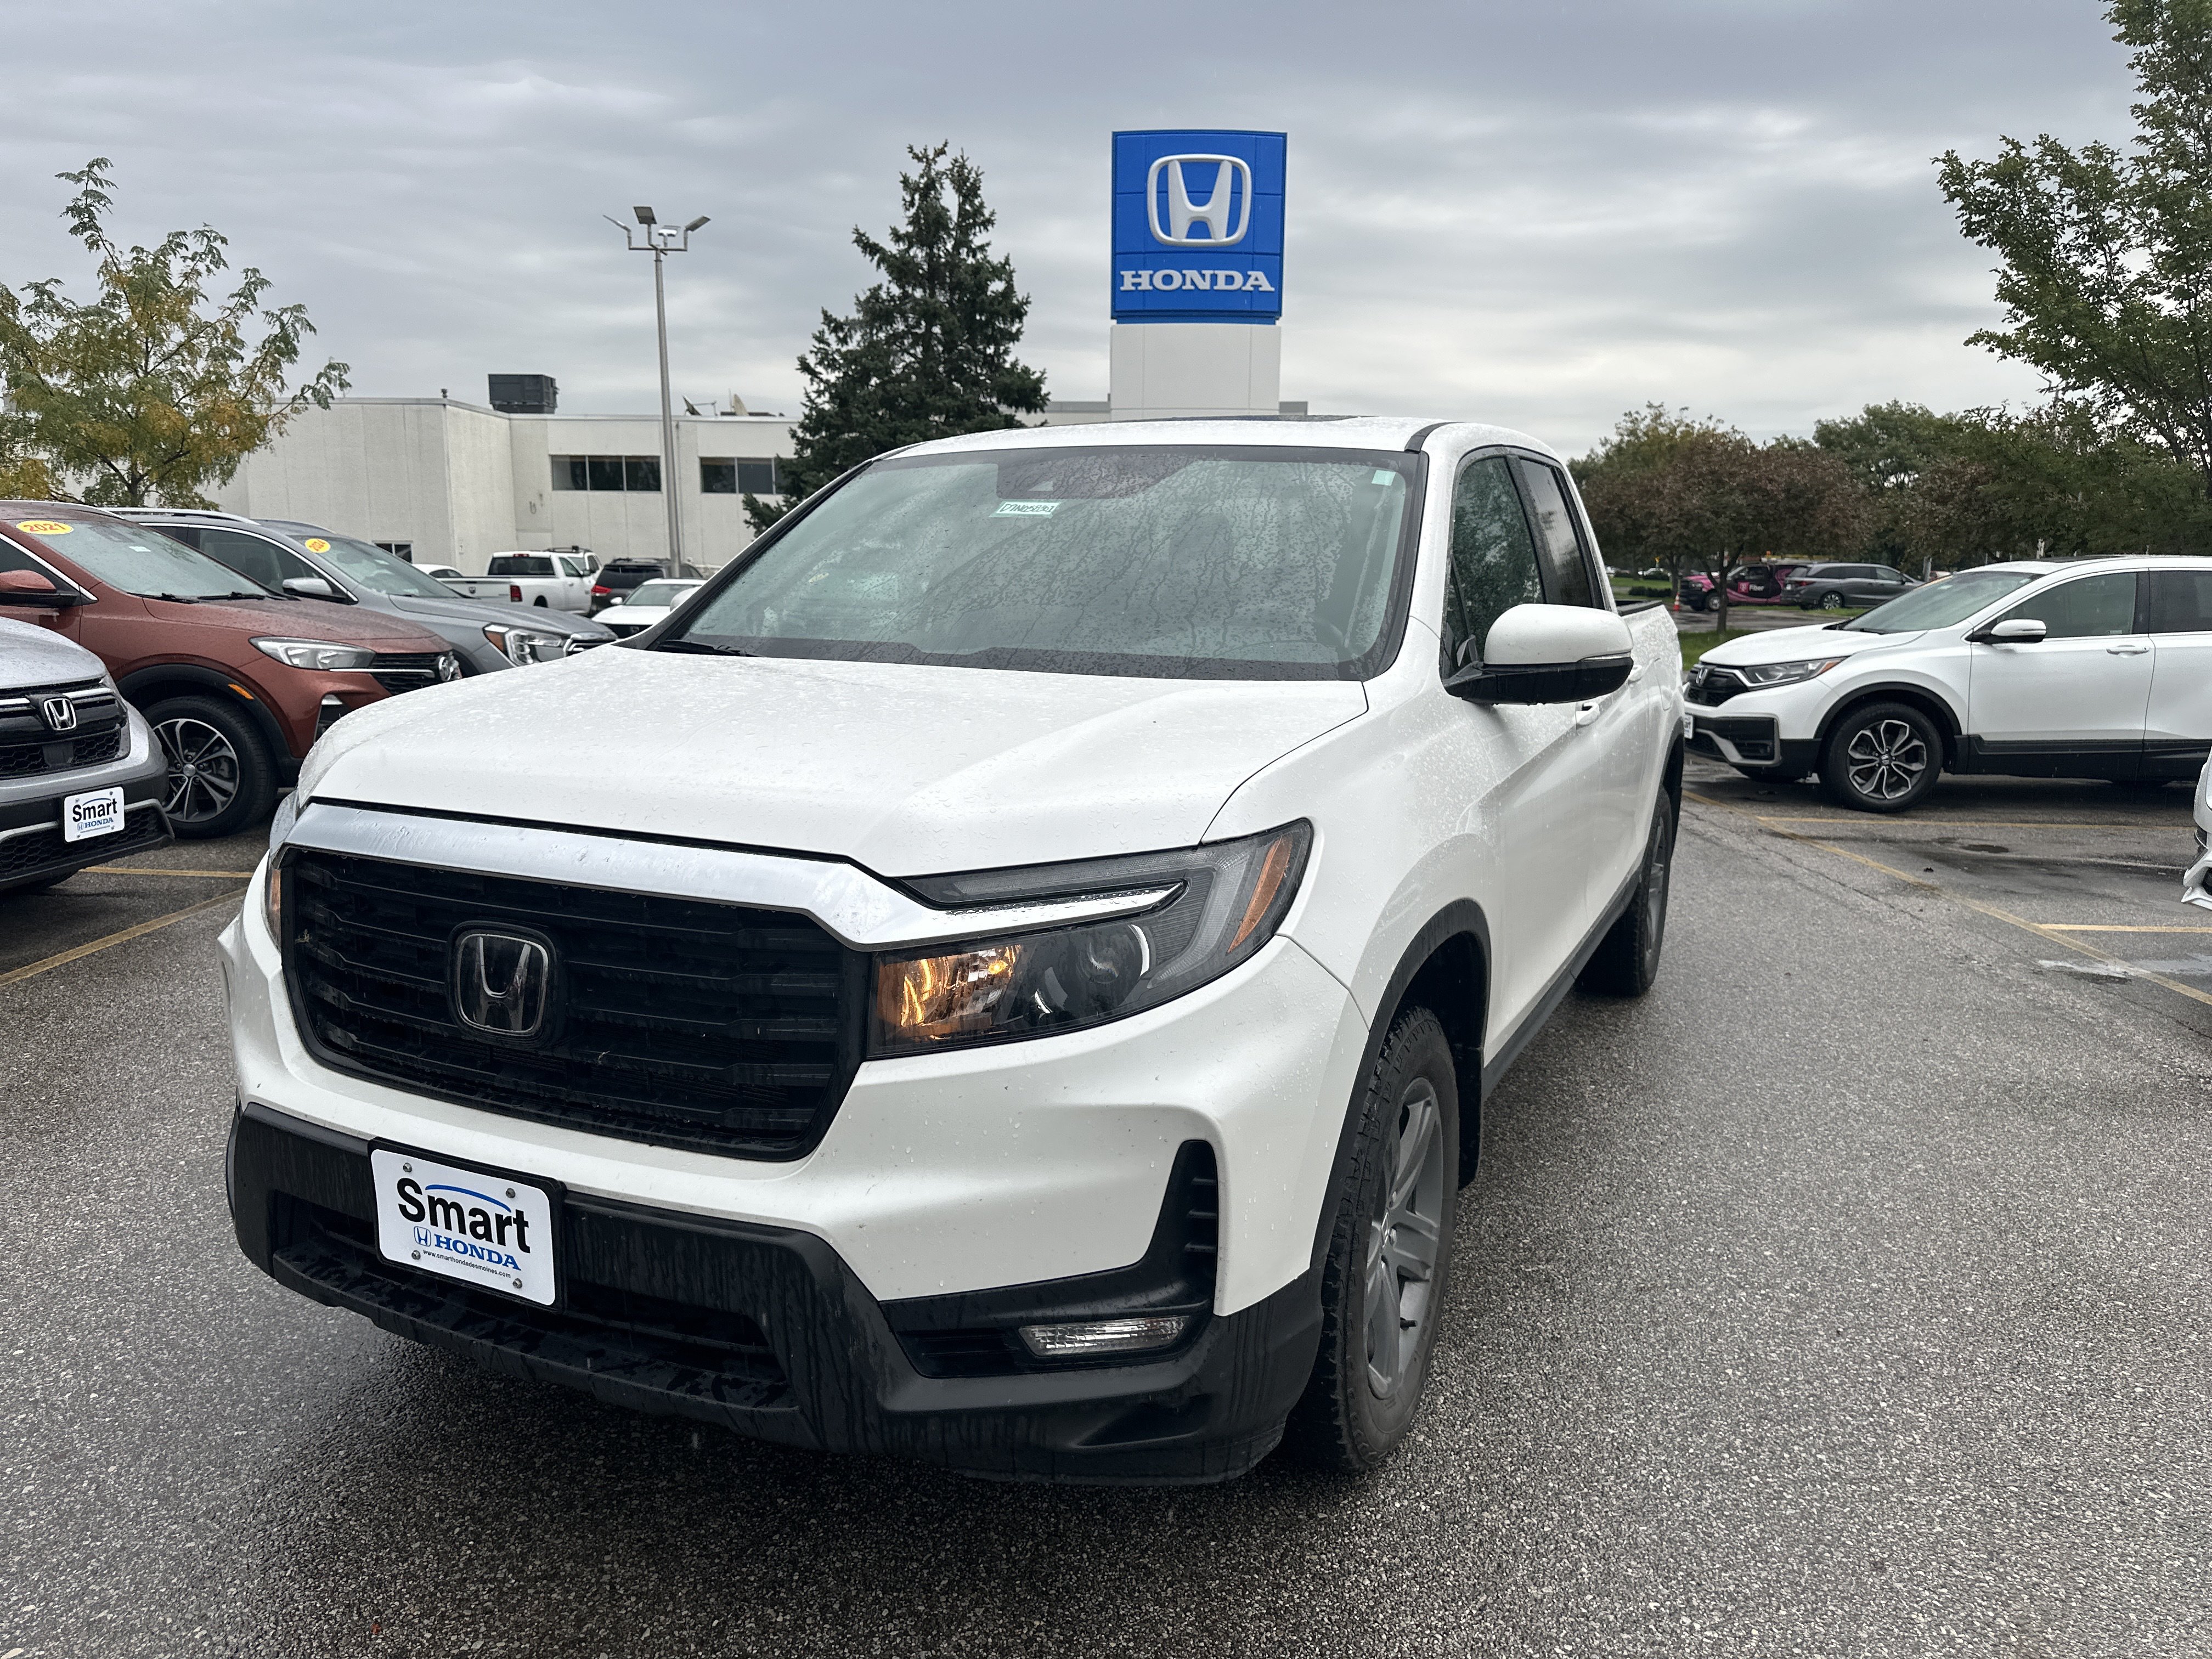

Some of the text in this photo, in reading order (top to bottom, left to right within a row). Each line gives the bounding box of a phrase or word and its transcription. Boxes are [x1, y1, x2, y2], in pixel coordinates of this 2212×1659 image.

[1120, 269, 1275, 292] HONDA
[23, 523, 66, 532] 2021
[1749, 584, 1764, 592] Fiber
[72, 798, 117, 822] Smart
[84, 817, 114, 828] HONDA
[397, 1177, 531, 1254] Smart
[422, 1249, 511, 1279] www.smarthondadesmoines.com
[434, 1234, 522, 1271] HONDA
